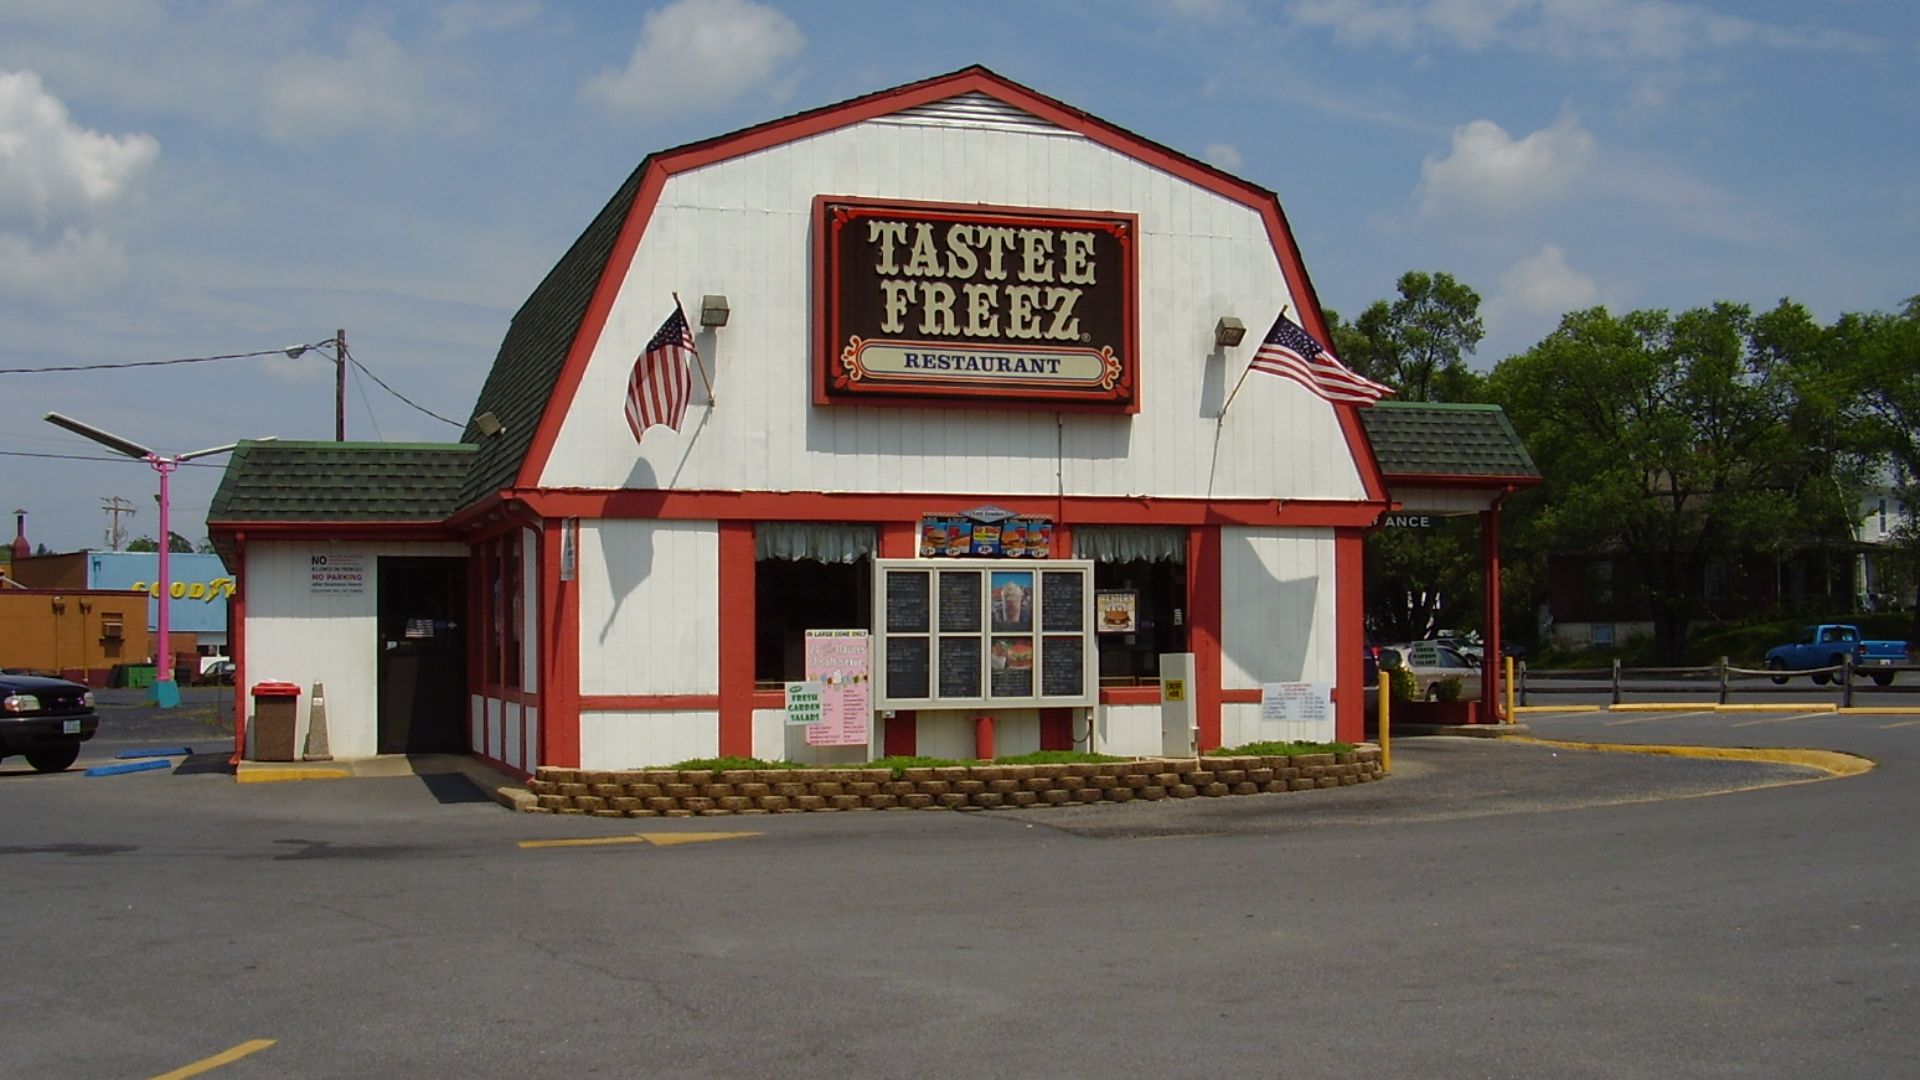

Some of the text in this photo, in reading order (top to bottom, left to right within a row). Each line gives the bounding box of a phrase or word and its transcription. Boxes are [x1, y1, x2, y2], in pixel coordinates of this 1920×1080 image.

[867, 219, 1097, 285] TASTEE
[880, 279, 1083, 340] FREEZ
[904, 352, 1061, 374] RESTAURANT
[312, 555, 327, 564] NO
[792, 694, 818, 702] FRESH
[788, 703, 820, 712] GARDEN
[790, 713, 820, 722] SALADS
